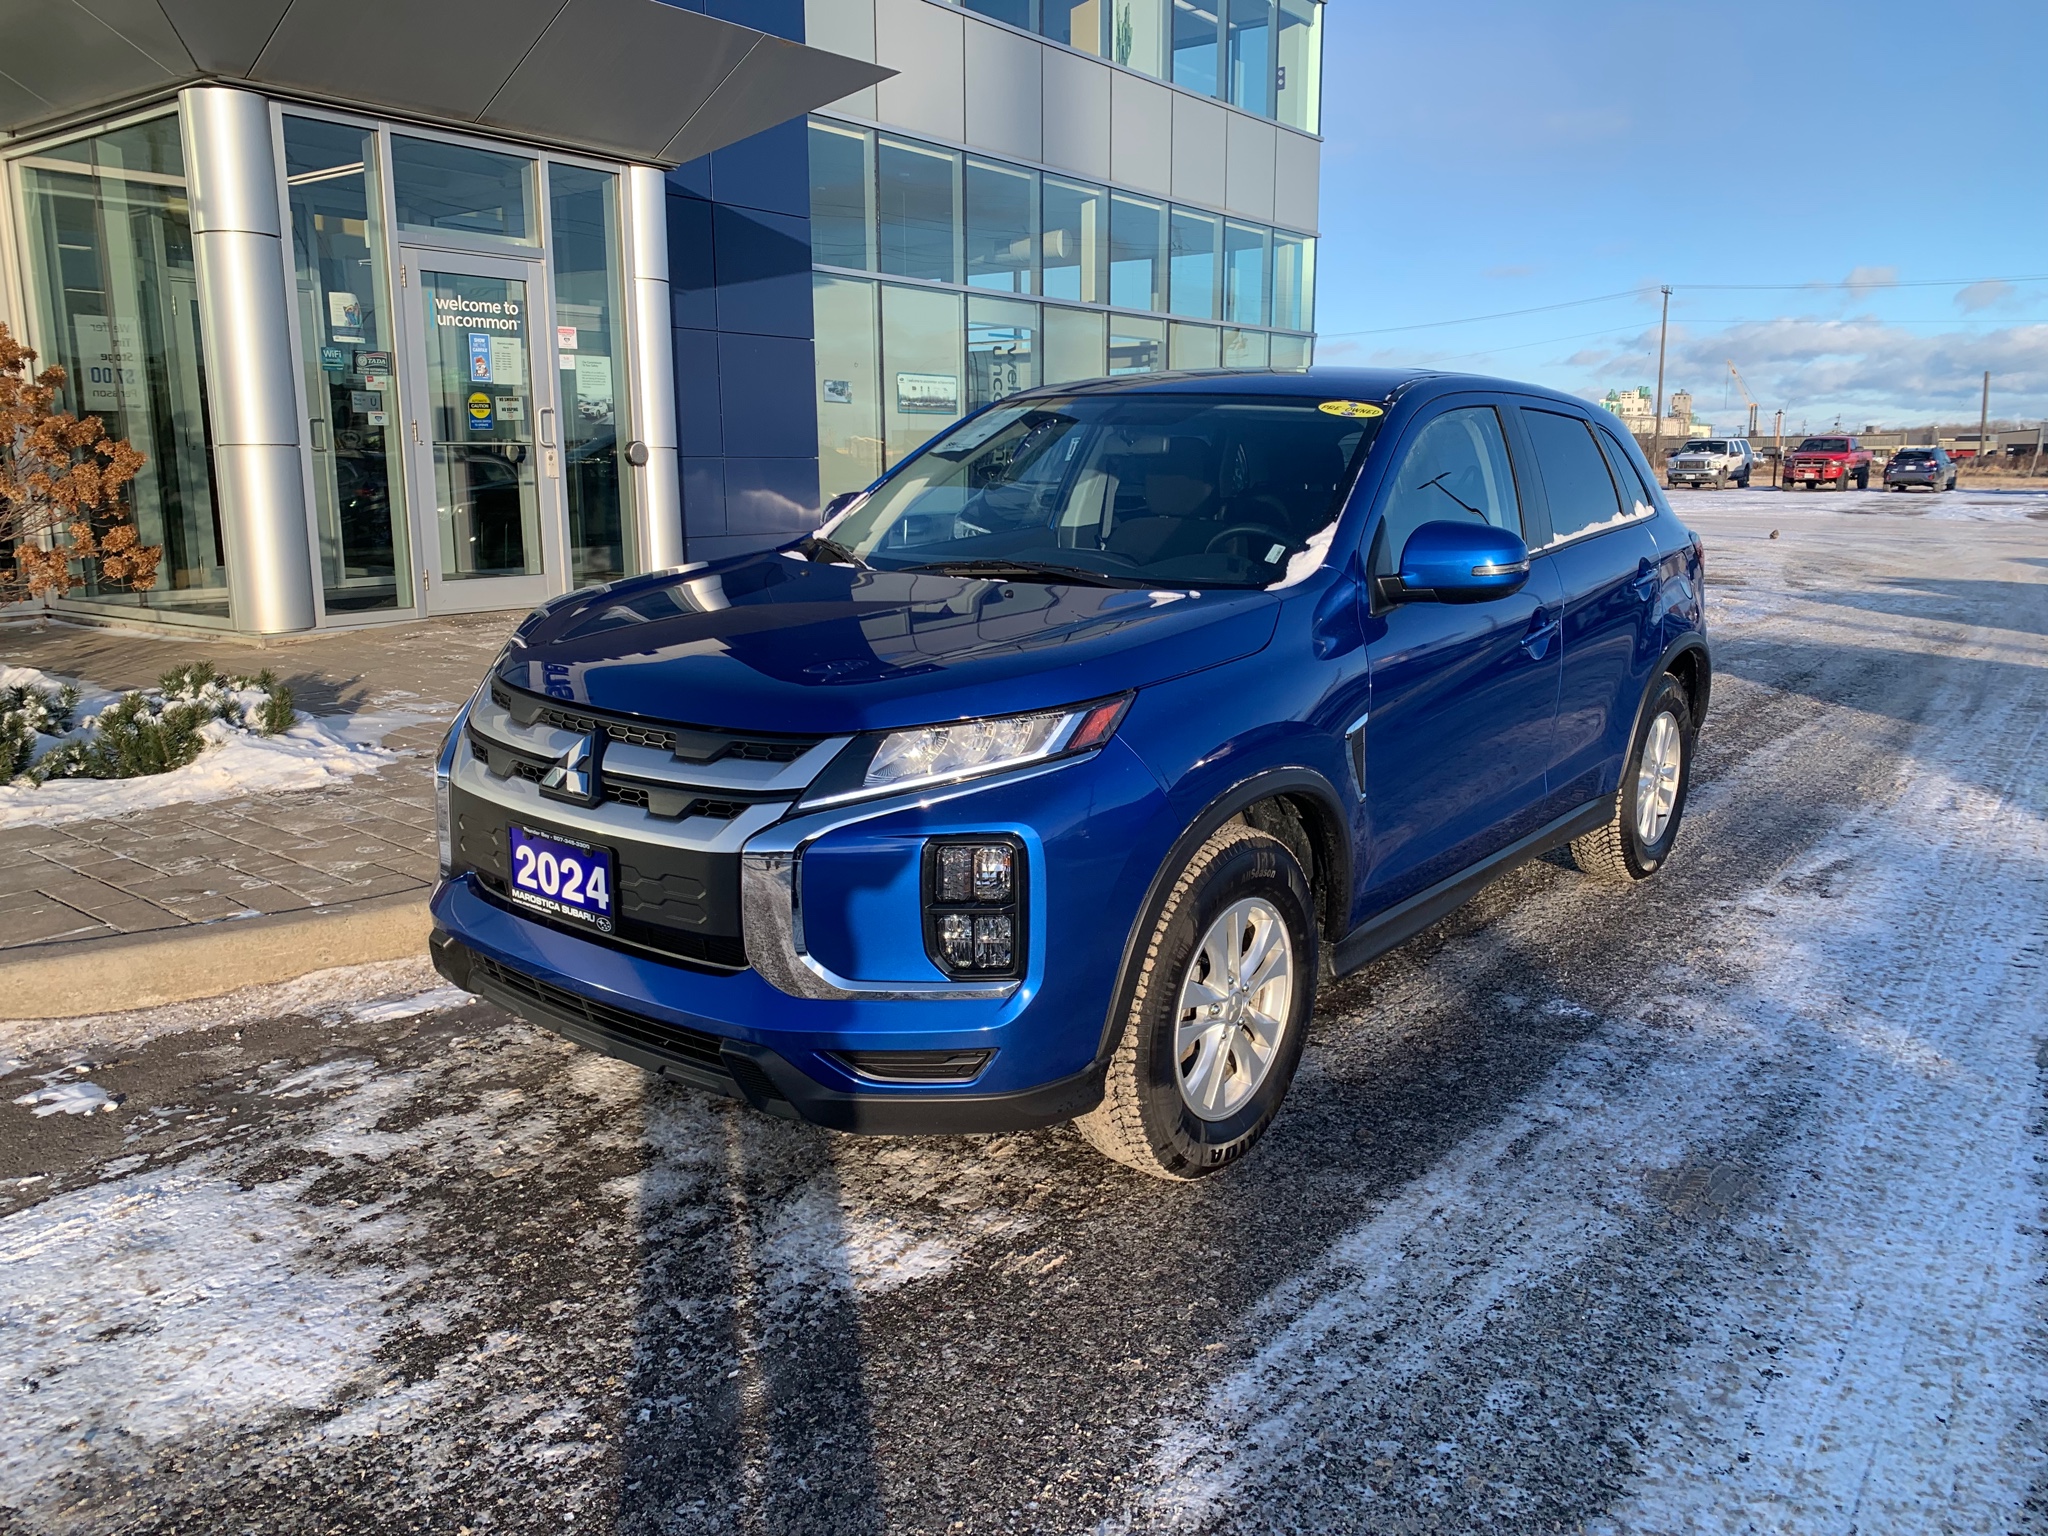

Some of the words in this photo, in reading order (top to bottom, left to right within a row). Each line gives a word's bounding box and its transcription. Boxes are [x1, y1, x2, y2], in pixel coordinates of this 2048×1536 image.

[435, 295, 501, 314] welcome
[503, 301, 519, 315] to
[437, 314, 517, 330] uncommon
[323, 350, 342, 358] WiFi
[1321, 404, 1380, 415] PRE-OWNED
[515, 845, 609, 910] 2024
[512, 889, 561, 912] MAROSTICA
[561, 905, 596, 922] SUBARU
